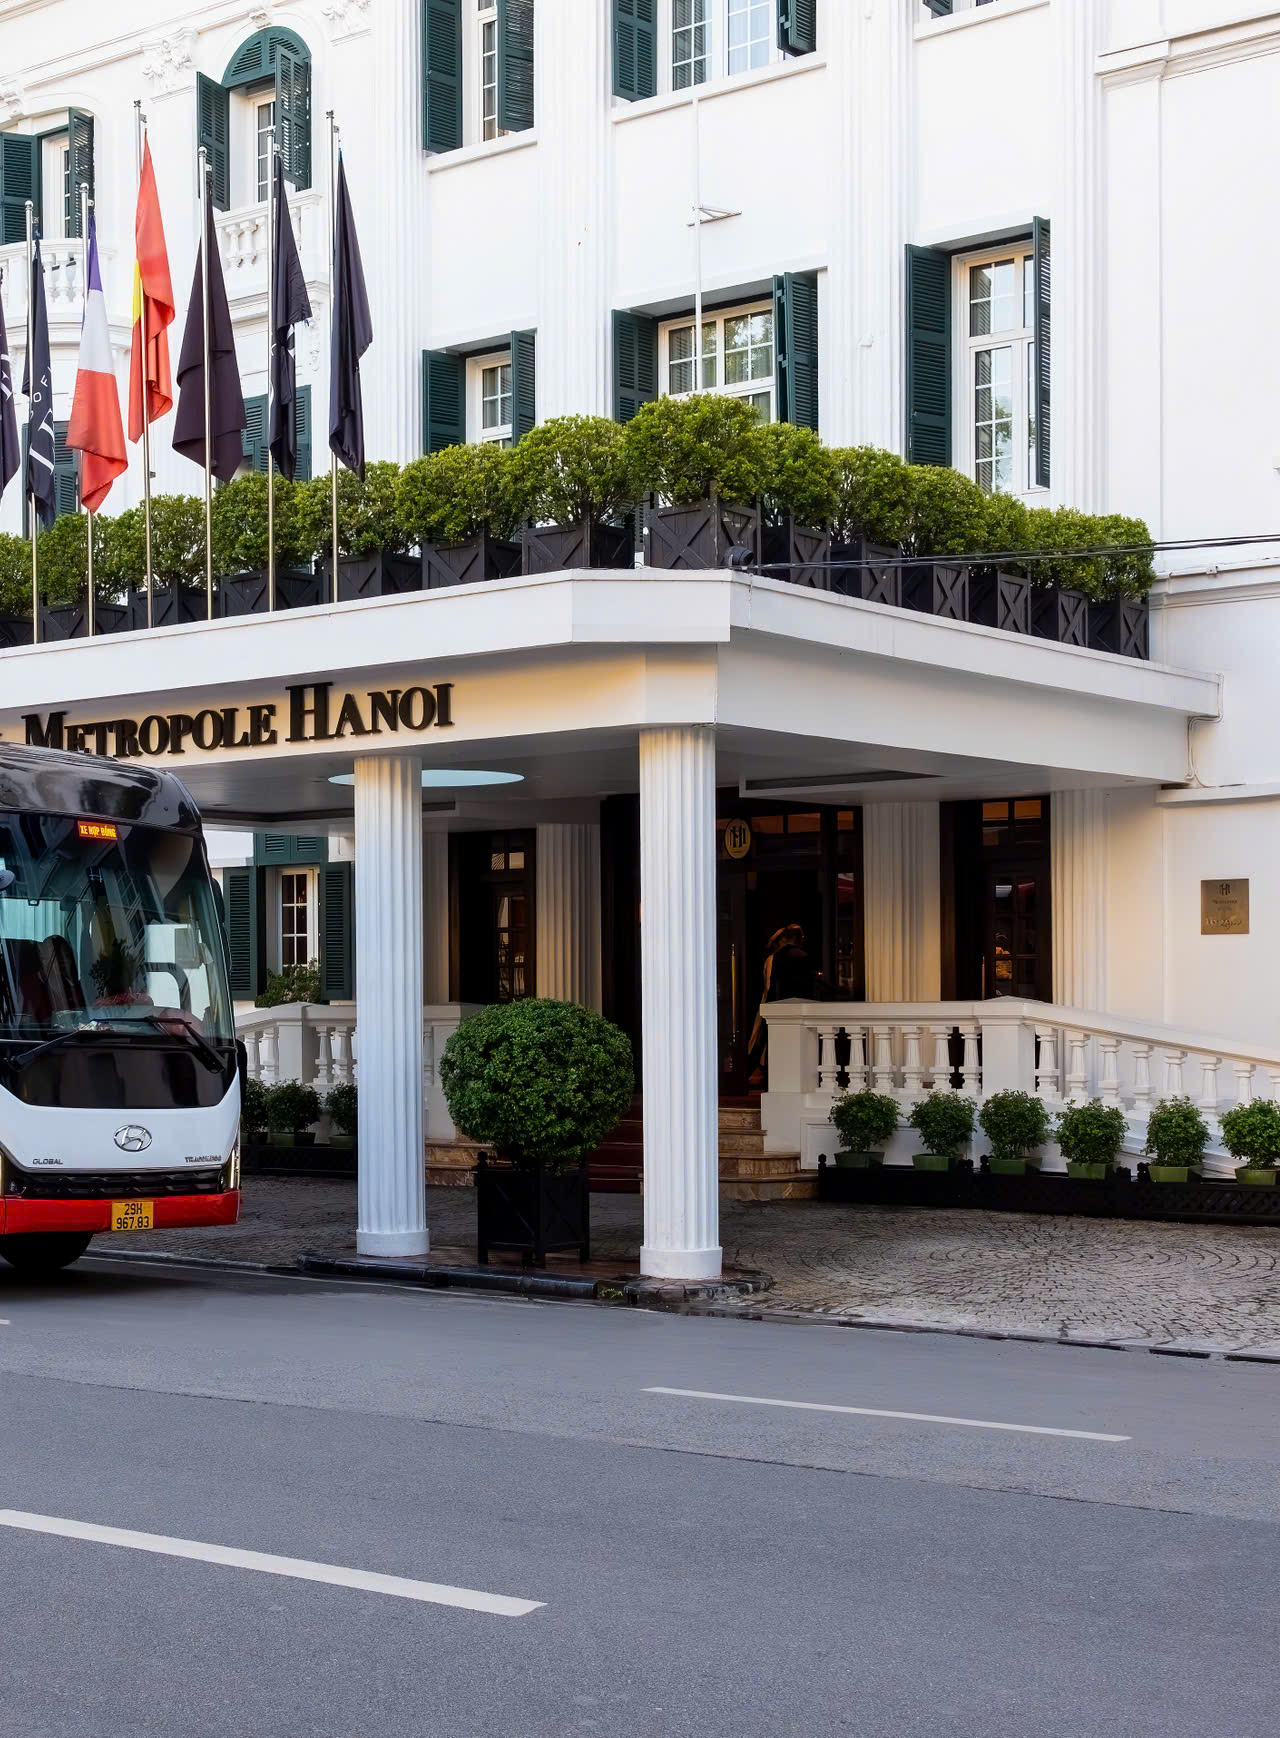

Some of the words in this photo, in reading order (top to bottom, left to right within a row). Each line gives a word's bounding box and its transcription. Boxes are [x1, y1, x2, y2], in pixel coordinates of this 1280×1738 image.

[285, 681, 455, 742] HANOI
[124, 1203, 143, 1215] 29H
[116, 1216, 150, 1230] 967.83
